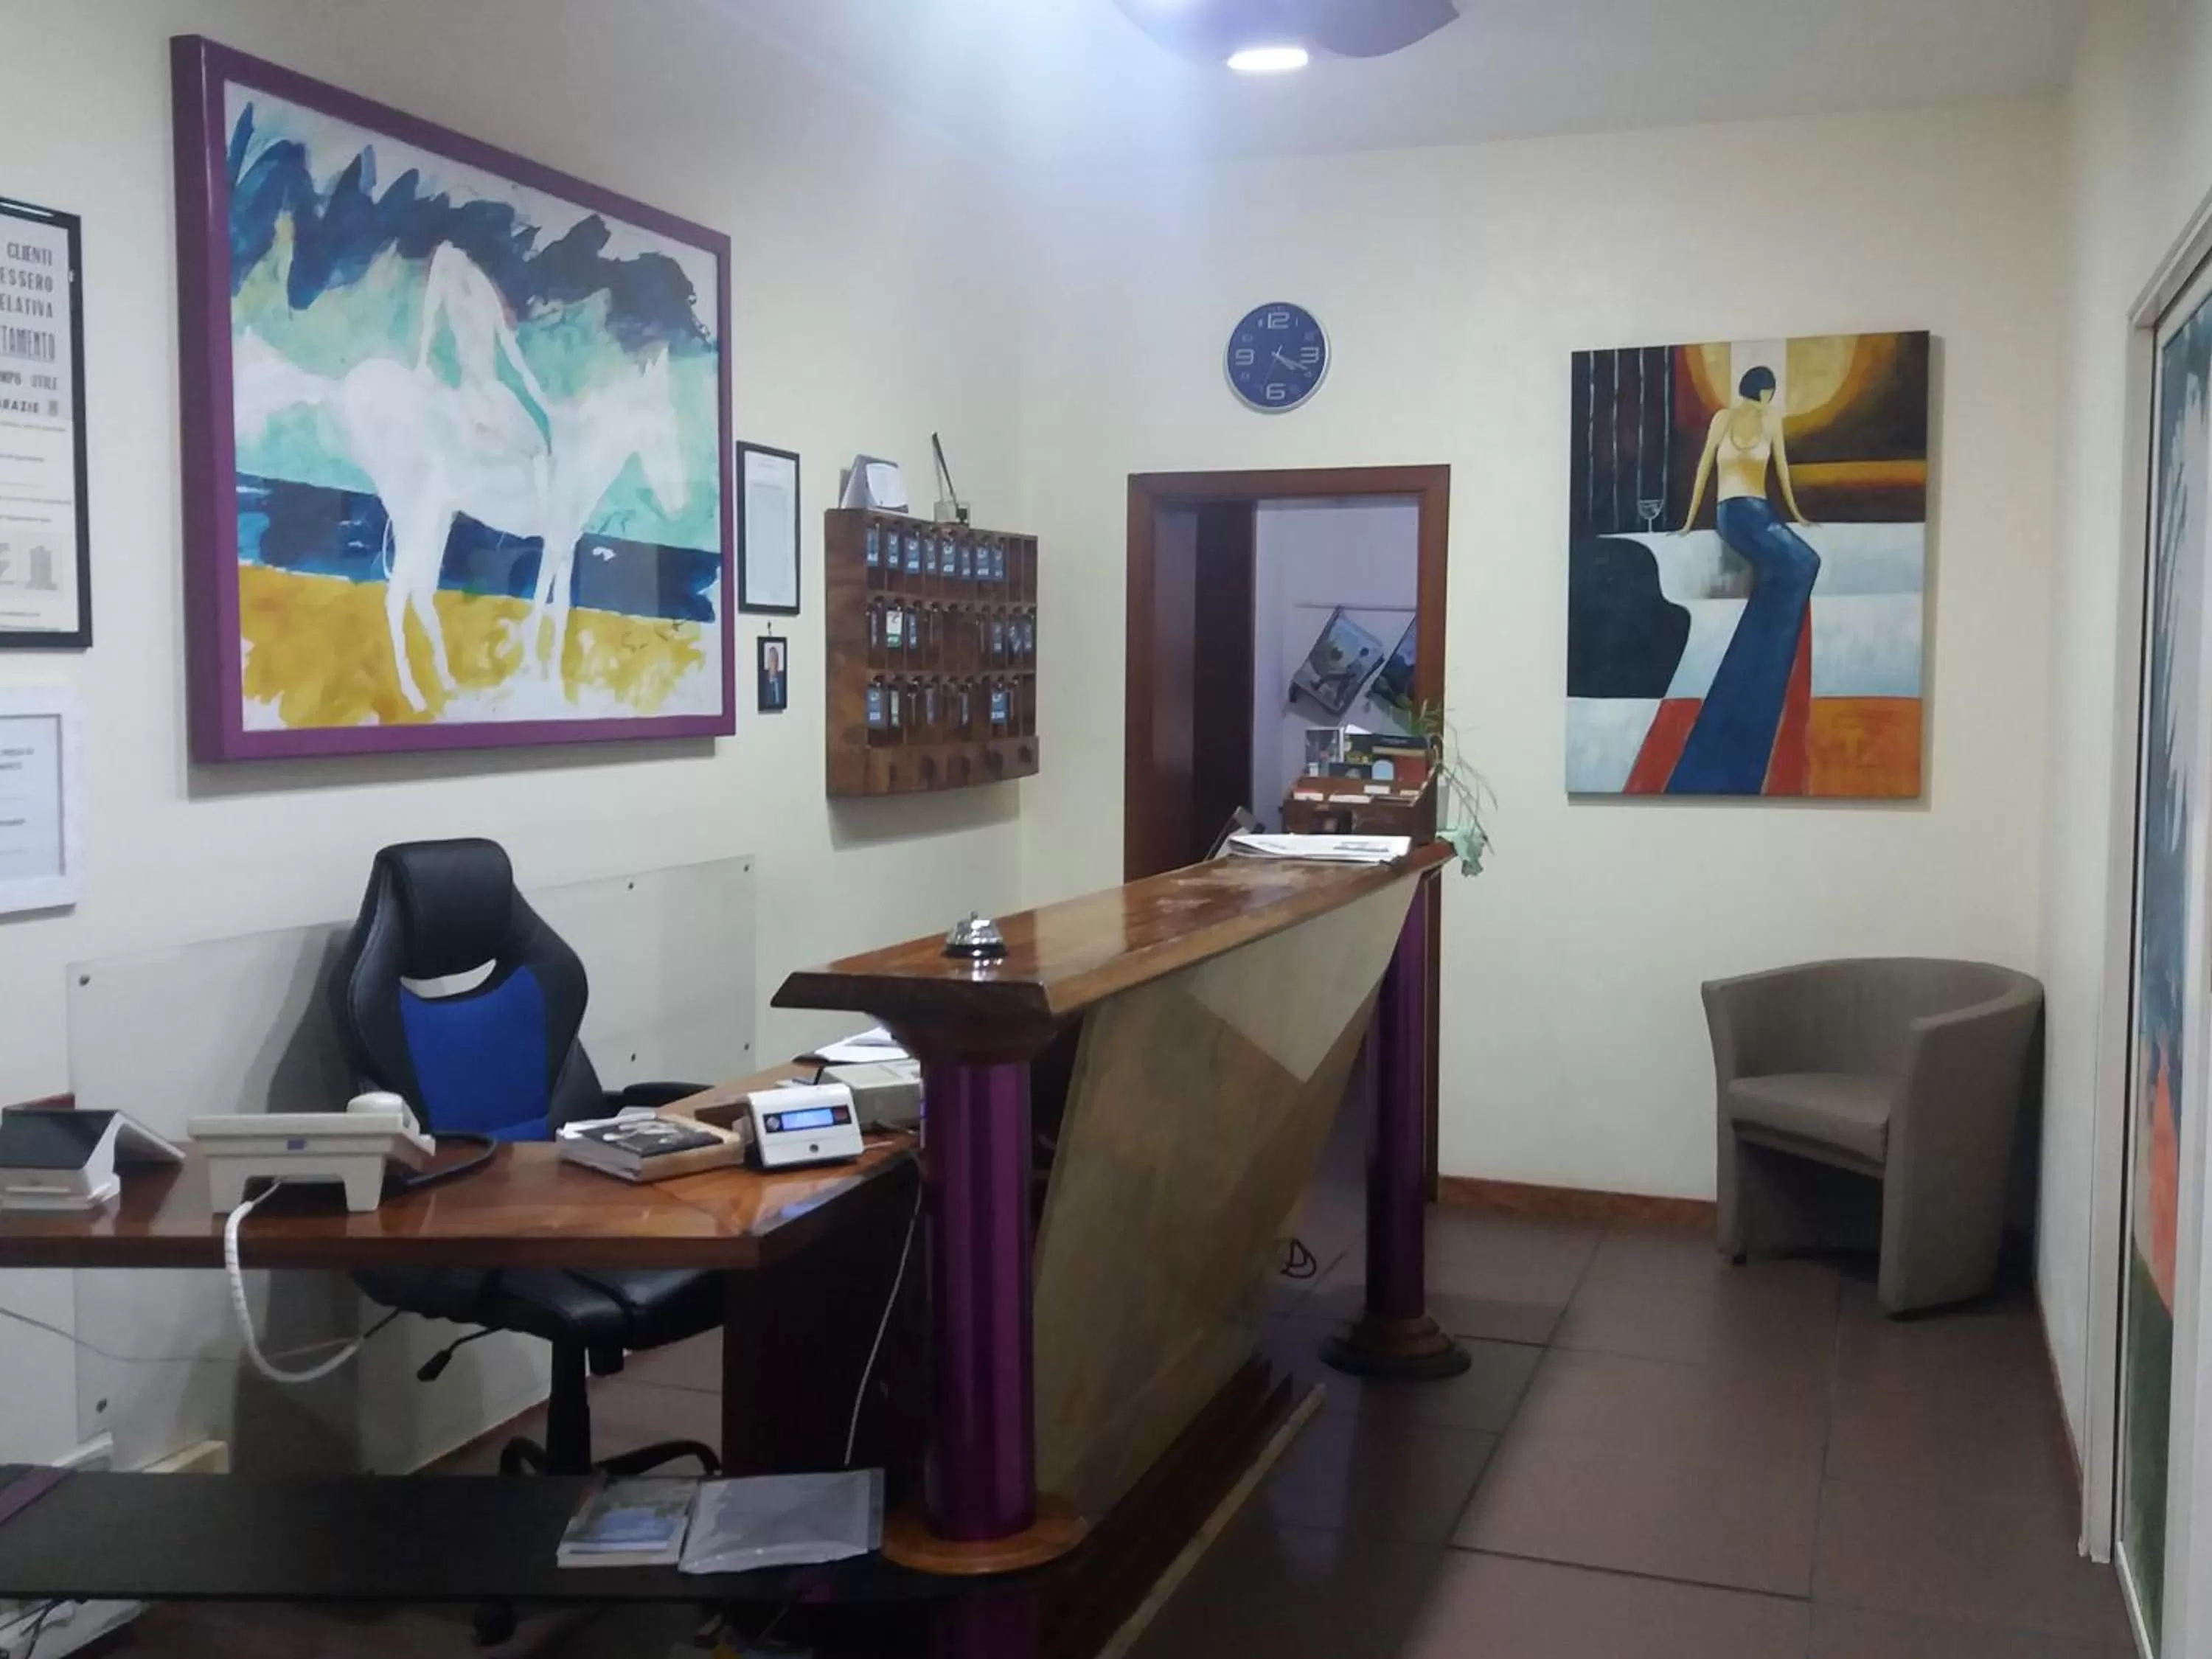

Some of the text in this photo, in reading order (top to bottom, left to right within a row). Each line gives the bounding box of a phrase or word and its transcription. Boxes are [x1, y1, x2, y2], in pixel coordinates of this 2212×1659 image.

[7, 242, 52, 266] CLIENTI
[1267, 312, 1290, 329] 12
[1235, 349, 1254, 365] 9
[1299, 347, 1319, 364] 3
[1266, 383, 1285, 400] 6
